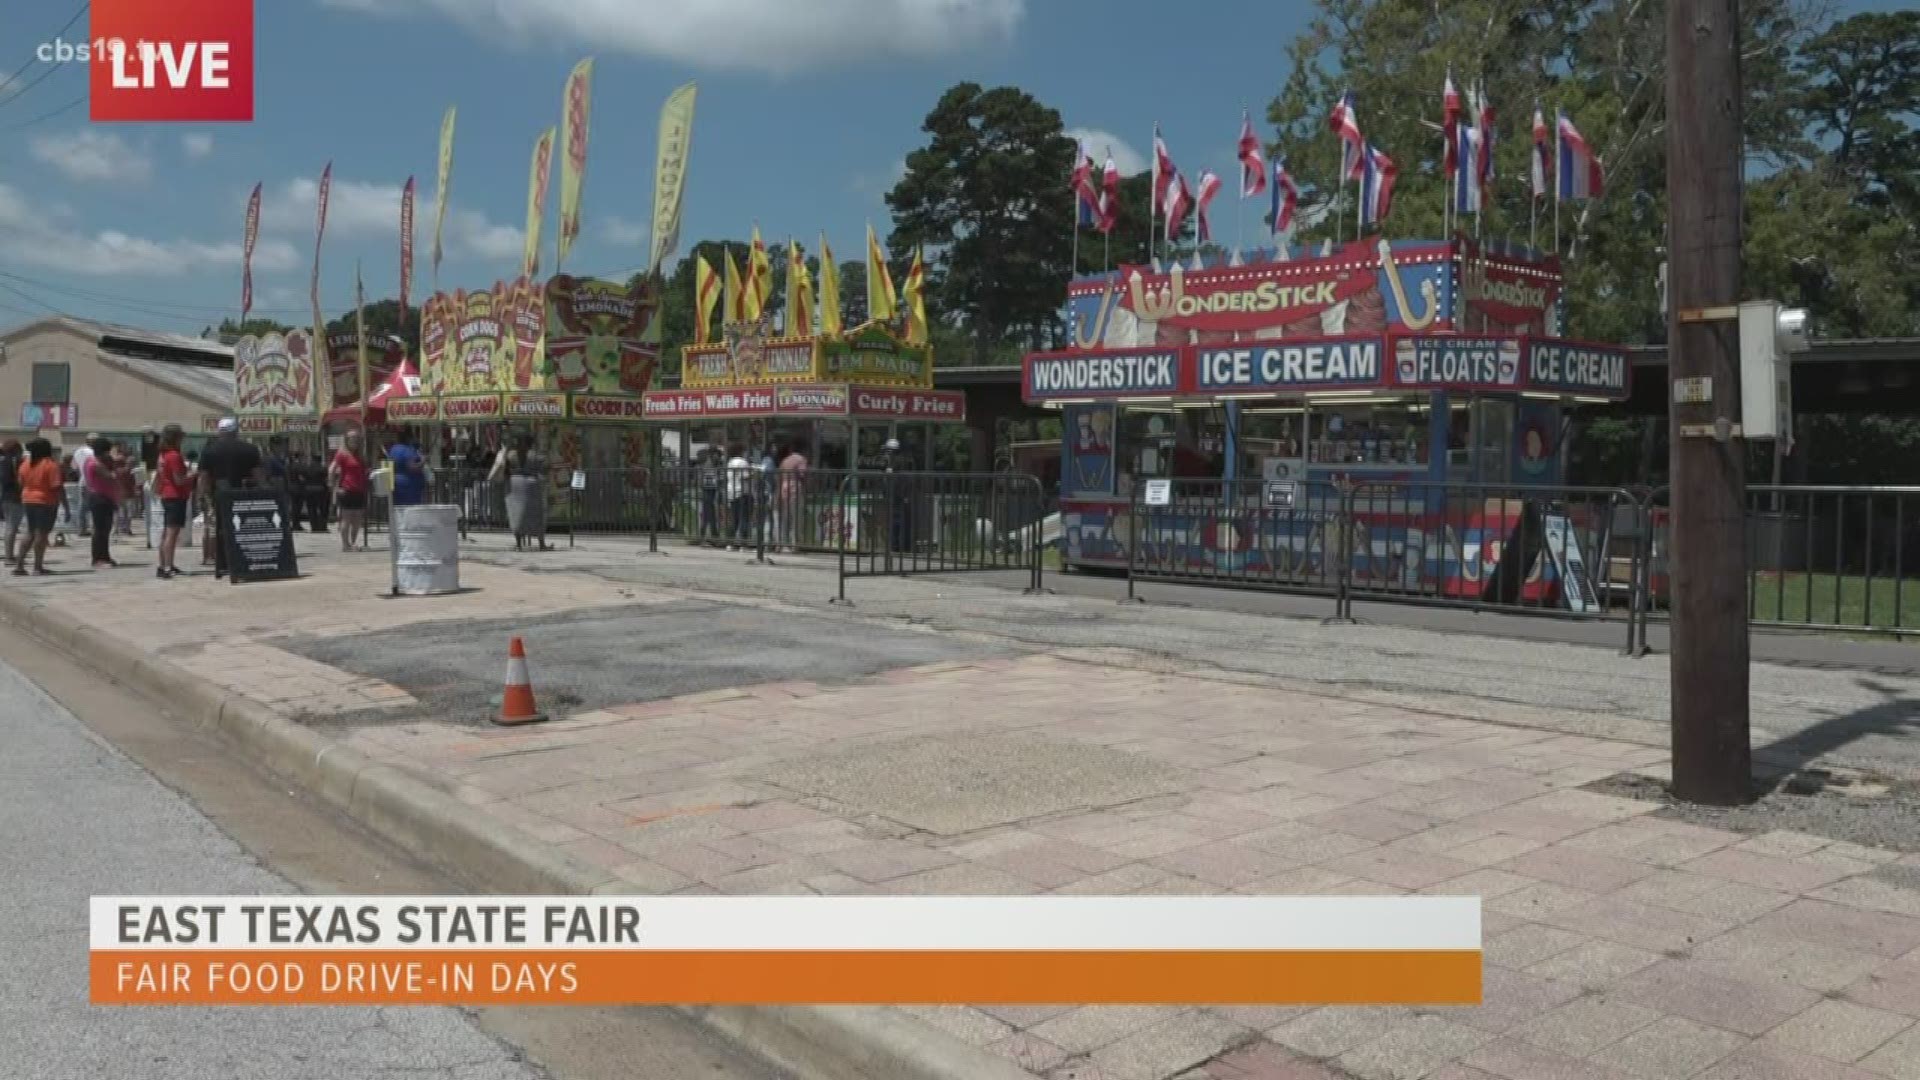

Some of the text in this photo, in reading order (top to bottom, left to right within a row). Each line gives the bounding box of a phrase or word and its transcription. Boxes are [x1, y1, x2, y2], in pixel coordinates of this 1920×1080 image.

[1418, 340, 1496, 348] ICE CREAM
[827, 353, 921, 374] LEMNADE
[1034, 354, 1172, 390] WONDERSTICK
[1203, 343, 1376, 384] ICE CREAM
[1419, 350, 1496, 382] FLOATS
[1530, 346, 1624, 387] ICE CREAM
[507, 401, 562, 416] LEMONADE
[586, 400, 623, 415] CORN
[645, 395, 701, 412] French Fries
[705, 392, 771, 410] Waffle Fries
[779, 394, 842, 407] LEMONADE
[858, 394, 955, 413] Curly Fries
[49, 404, 61, 426] 1
